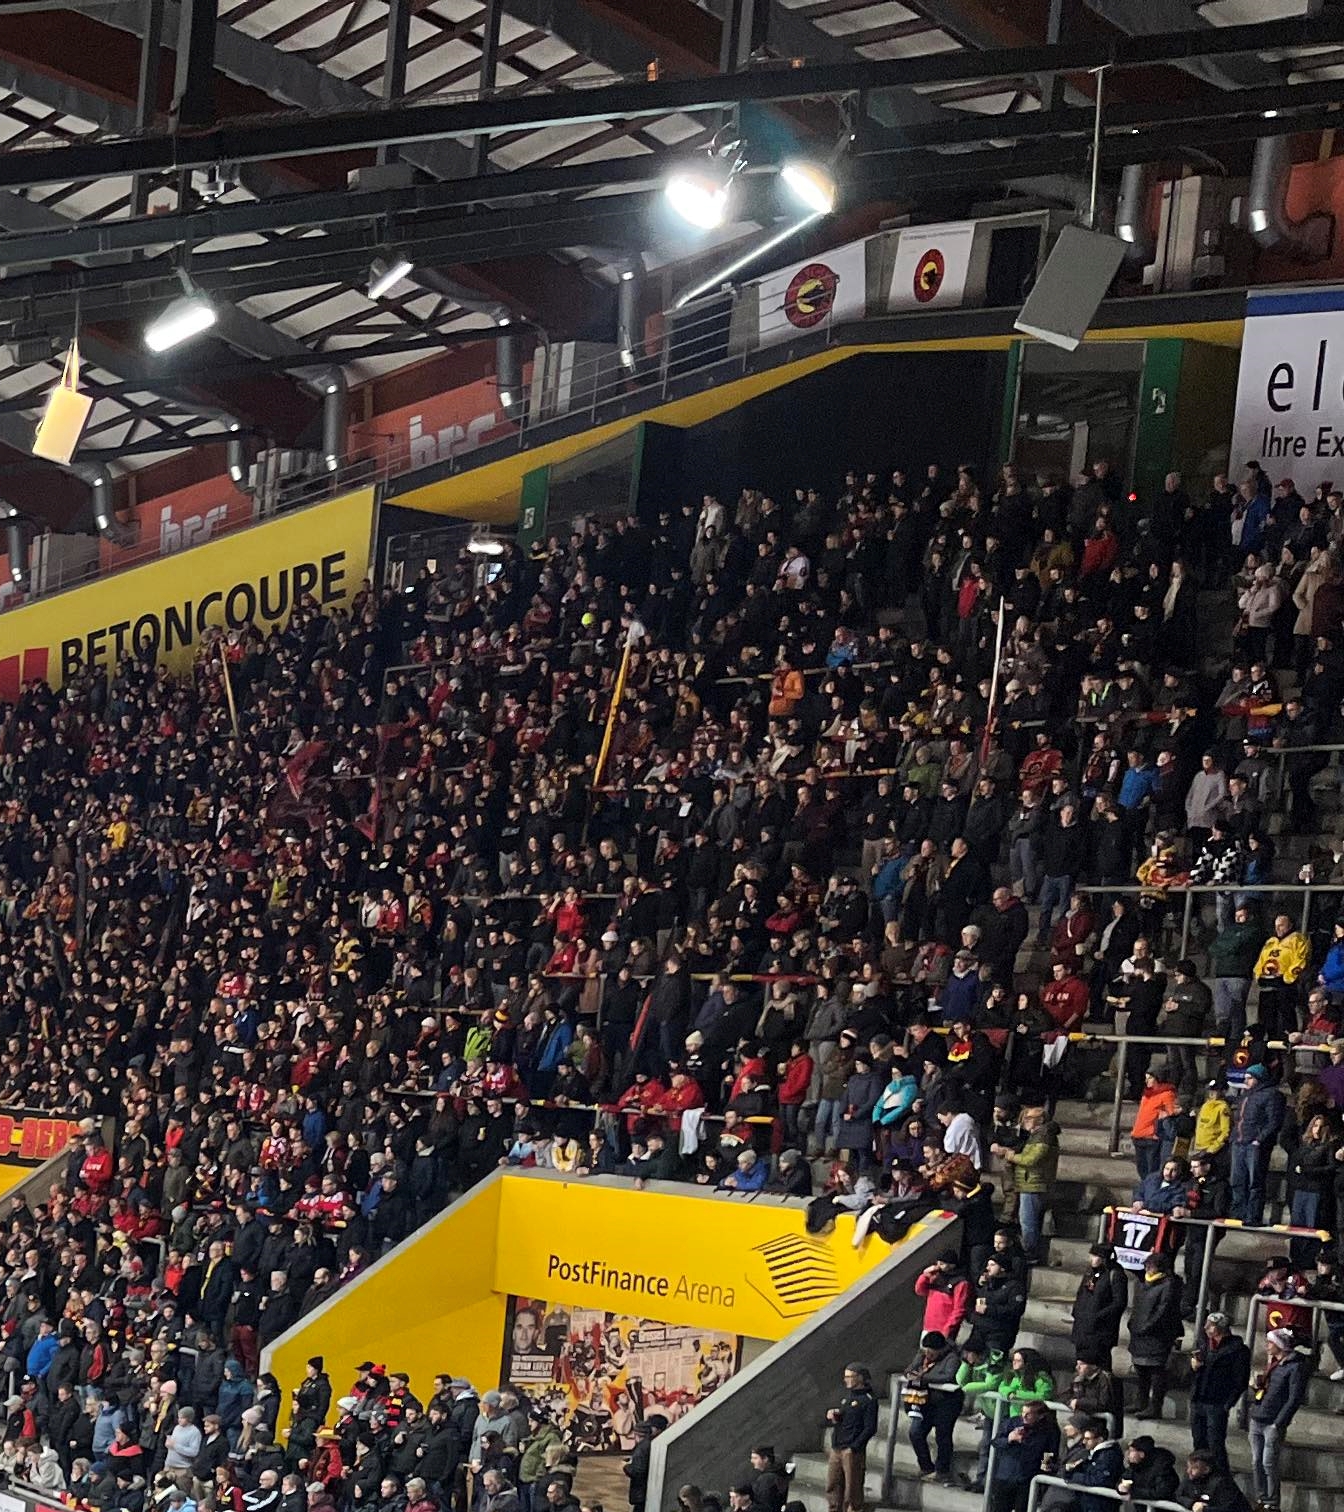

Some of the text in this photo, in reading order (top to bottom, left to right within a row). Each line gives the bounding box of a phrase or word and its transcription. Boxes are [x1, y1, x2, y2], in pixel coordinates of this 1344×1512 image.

[1266, 338, 1344, 412] el
[409, 412, 497, 468] hrs
[1261, 424, 1344, 458] Ihre Ex
[159, 504, 228, 556] hrs
[60, 551, 349, 683] BETONCOUPE
[1122, 1221, 1151, 1249] 17
[546, 1254, 737, 1309] PostFinance Arena
